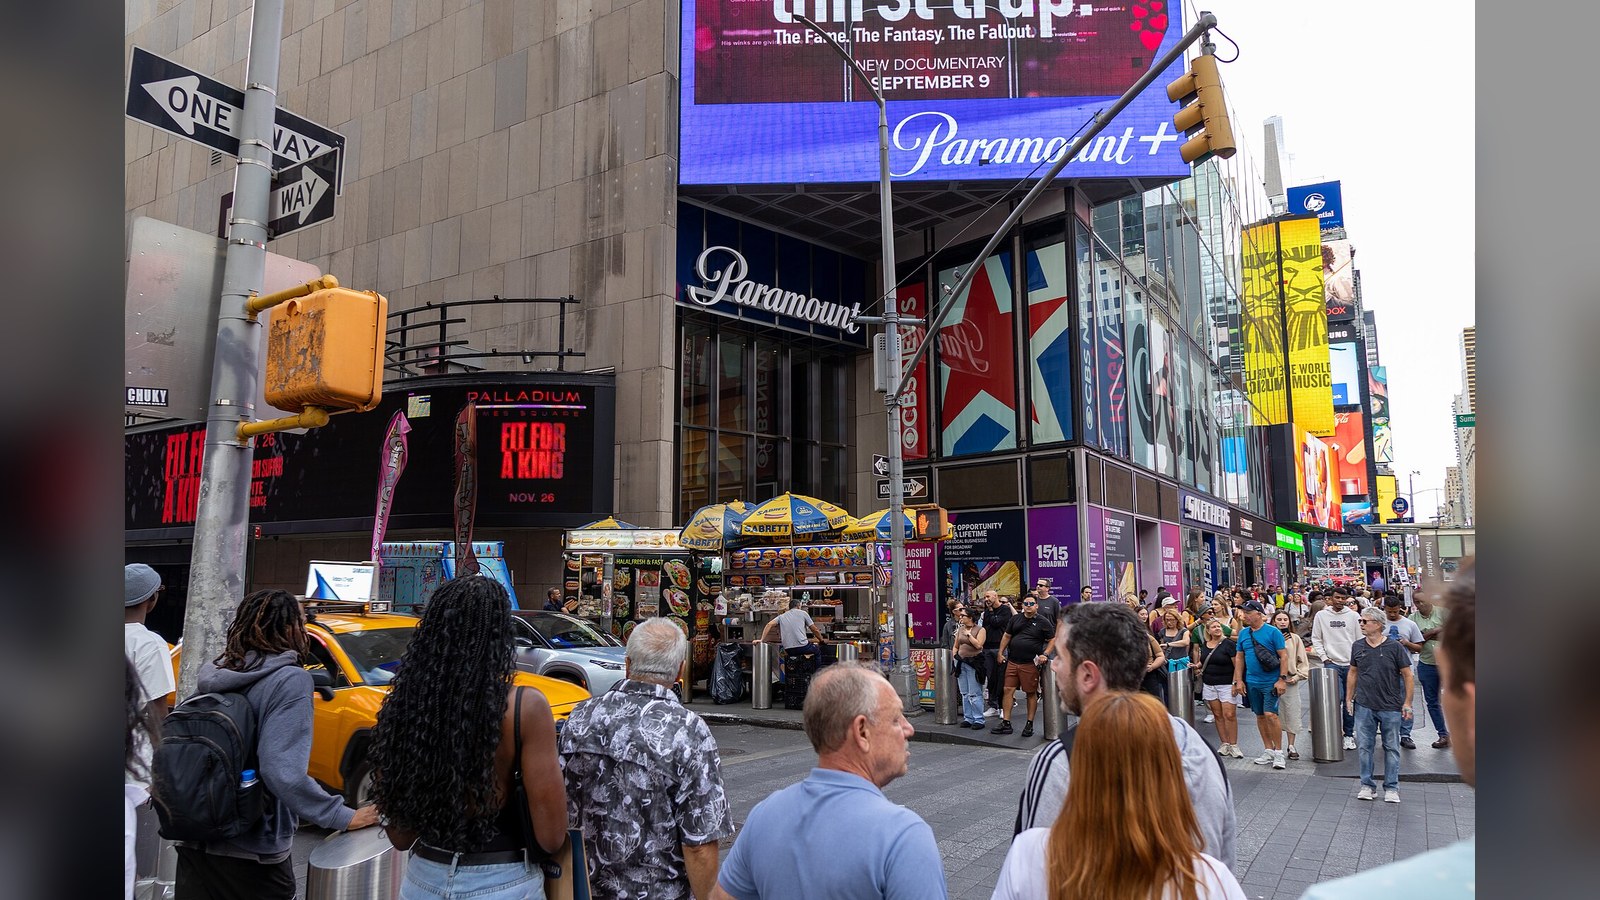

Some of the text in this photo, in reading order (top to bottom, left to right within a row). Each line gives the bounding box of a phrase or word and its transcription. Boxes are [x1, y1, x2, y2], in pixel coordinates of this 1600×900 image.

[773, 29, 800, 44] The
[853, 27, 880, 43] The
[884, 26, 945, 45] Fantasy.
[948, 25, 975, 41] The
[980, 24, 1035, 40] Fallout.
[856, 56, 1006, 72] NEW DOCUMENTARY
[871, 74, 991, 91] SEPTEMBER 9
[168, 86, 231, 132] ONE
[281, 178, 317, 215] WAY
[686, 246, 860, 334] Paramount
[1083, 348, 1093, 405] CBS
[128, 388, 167, 403] CHUKY
[468, 391, 580, 402] PALLADIUM
[901, 376, 918, 428] CBS
[262, 433, 275, 448] 26
[501, 421, 566, 452] FIT FOR
[165, 432, 188, 481] FIT
[501, 451, 564, 479] A KING
[881, 485, 890, 493] ON
[162, 478, 174, 523] A
[509, 493, 555, 502] NOV. 26
[1184, 495, 1230, 529] SKECHERS
[744, 524, 789, 533] SABRETT
[957, 522, 1003, 531] OPPORTUNITY
[959, 530, 987, 538] LIFETIME
[682, 537, 720, 548] SABRETT
[904, 548, 931, 557] LAGSHIP
[1425, 541, 1435, 577] Newsstand
[905, 559, 922, 569] ETAIL
[1038, 560, 1068, 568] BROADWAY
[906, 570, 921, 580] PACE
